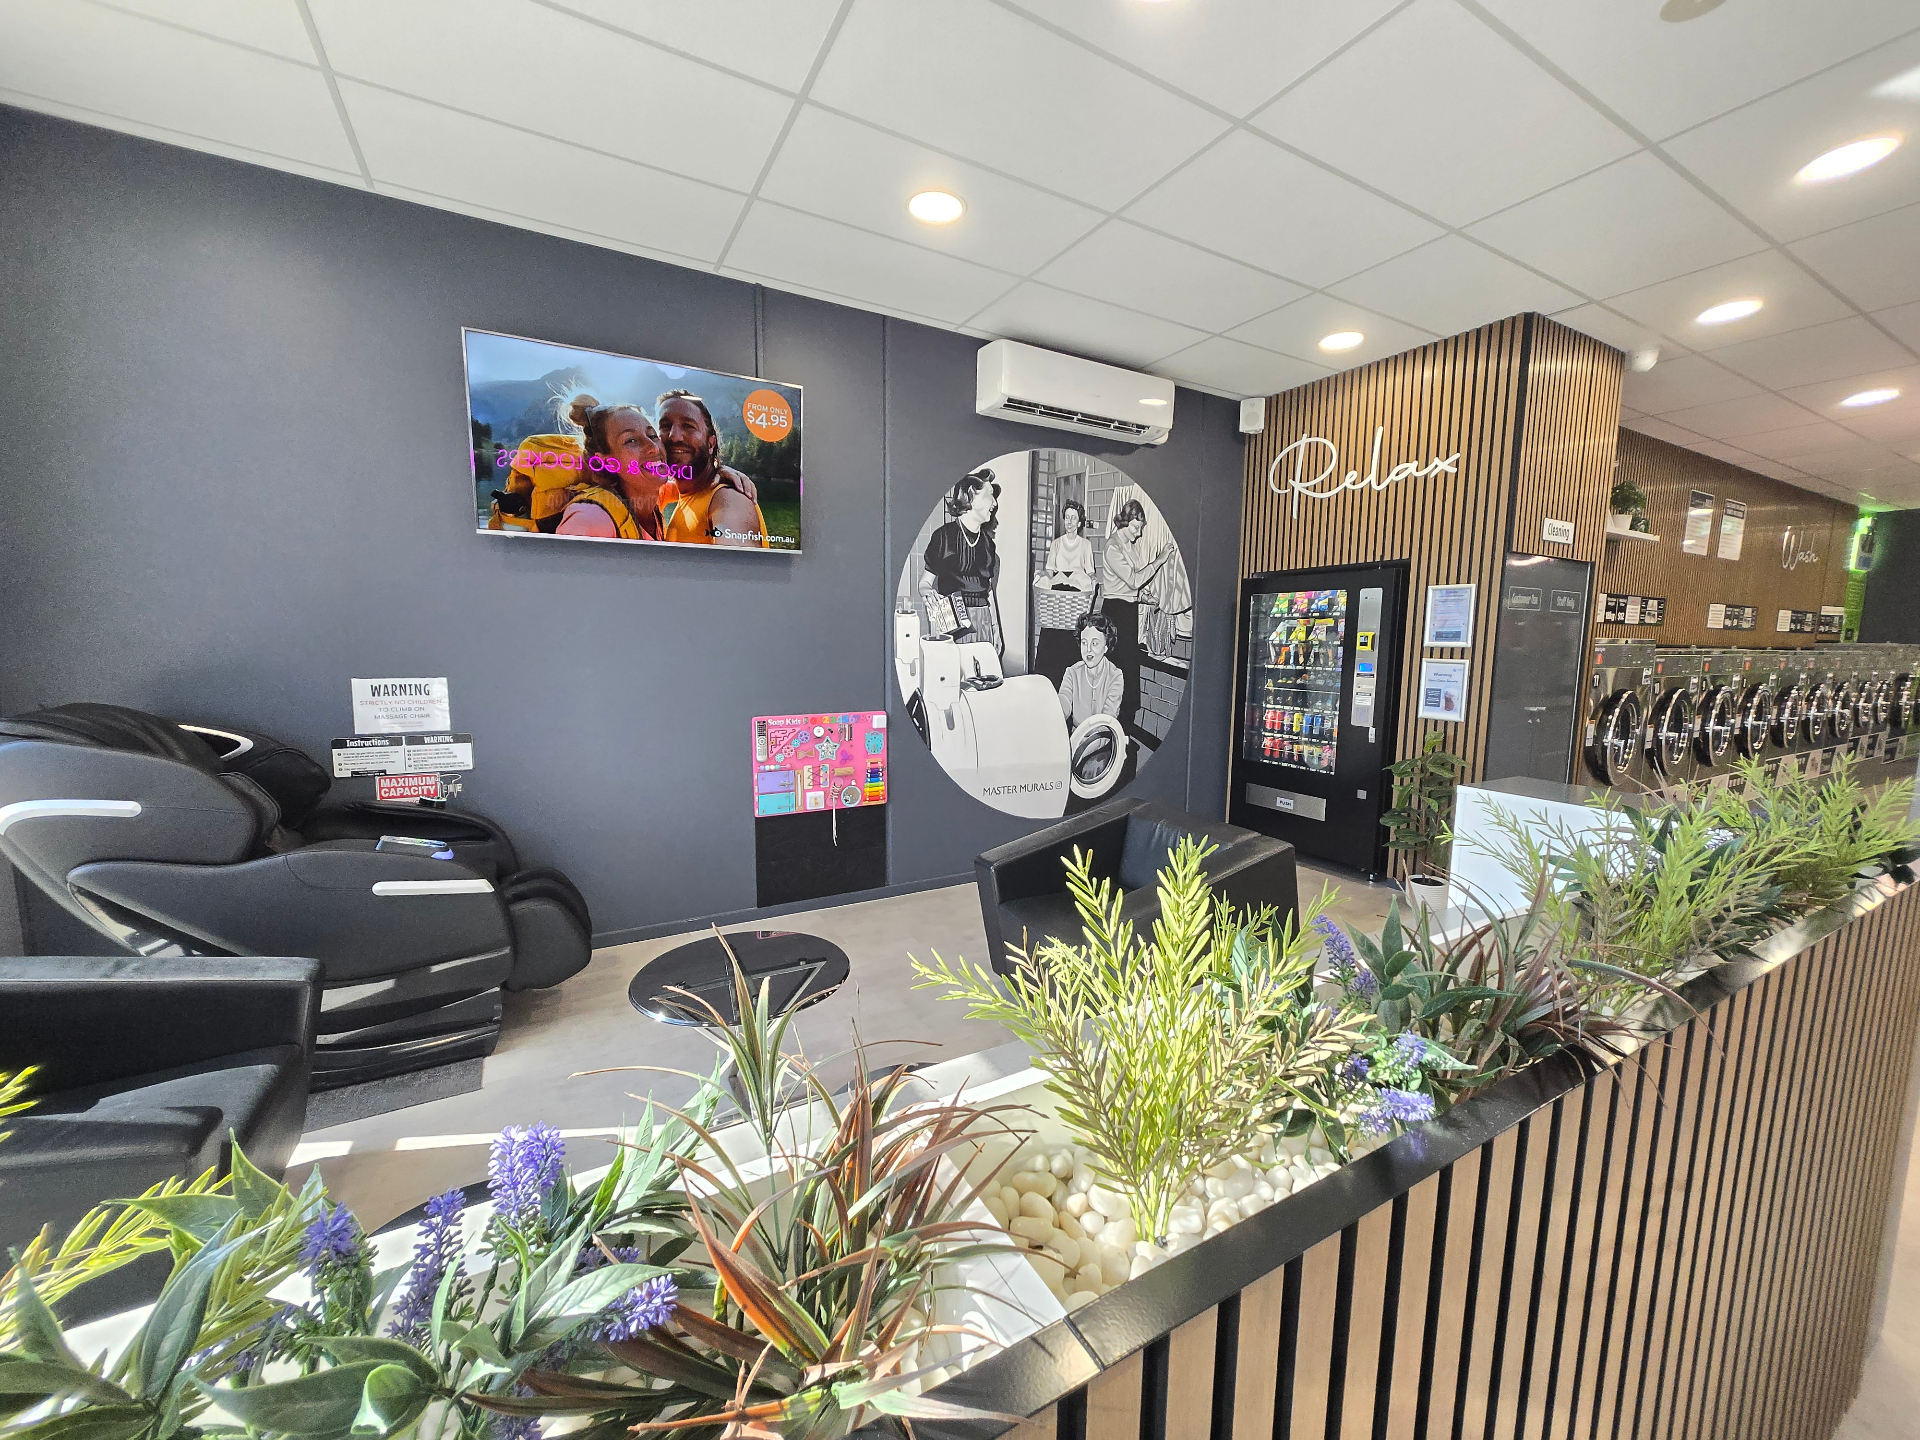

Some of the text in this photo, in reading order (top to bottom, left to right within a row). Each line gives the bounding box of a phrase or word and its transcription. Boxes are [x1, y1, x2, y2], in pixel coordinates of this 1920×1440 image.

[747, 402, 789, 415] FROM ONLY
[747, 410, 788, 429] $4.95
[1269, 425, 1461, 520] Relax
[724, 528, 795, 544] Snapfish.com.au
[1547, 522, 1570, 541] Cleaning
[1782, 525, 1820, 571] Wash
[370, 683, 430, 697] WARNING
[767, 718, 784, 727] Soap
[785, 718, 801, 726] Kids
[345, 738, 389, 748] Instructions
[424, 735, 454, 744] WARNING
[380, 775, 435, 788] MAXIMUM
[381, 784, 436, 797] CAPACITY
[982, 784, 1018, 797] MASTER
[1019, 781, 1054, 794] MURALS
